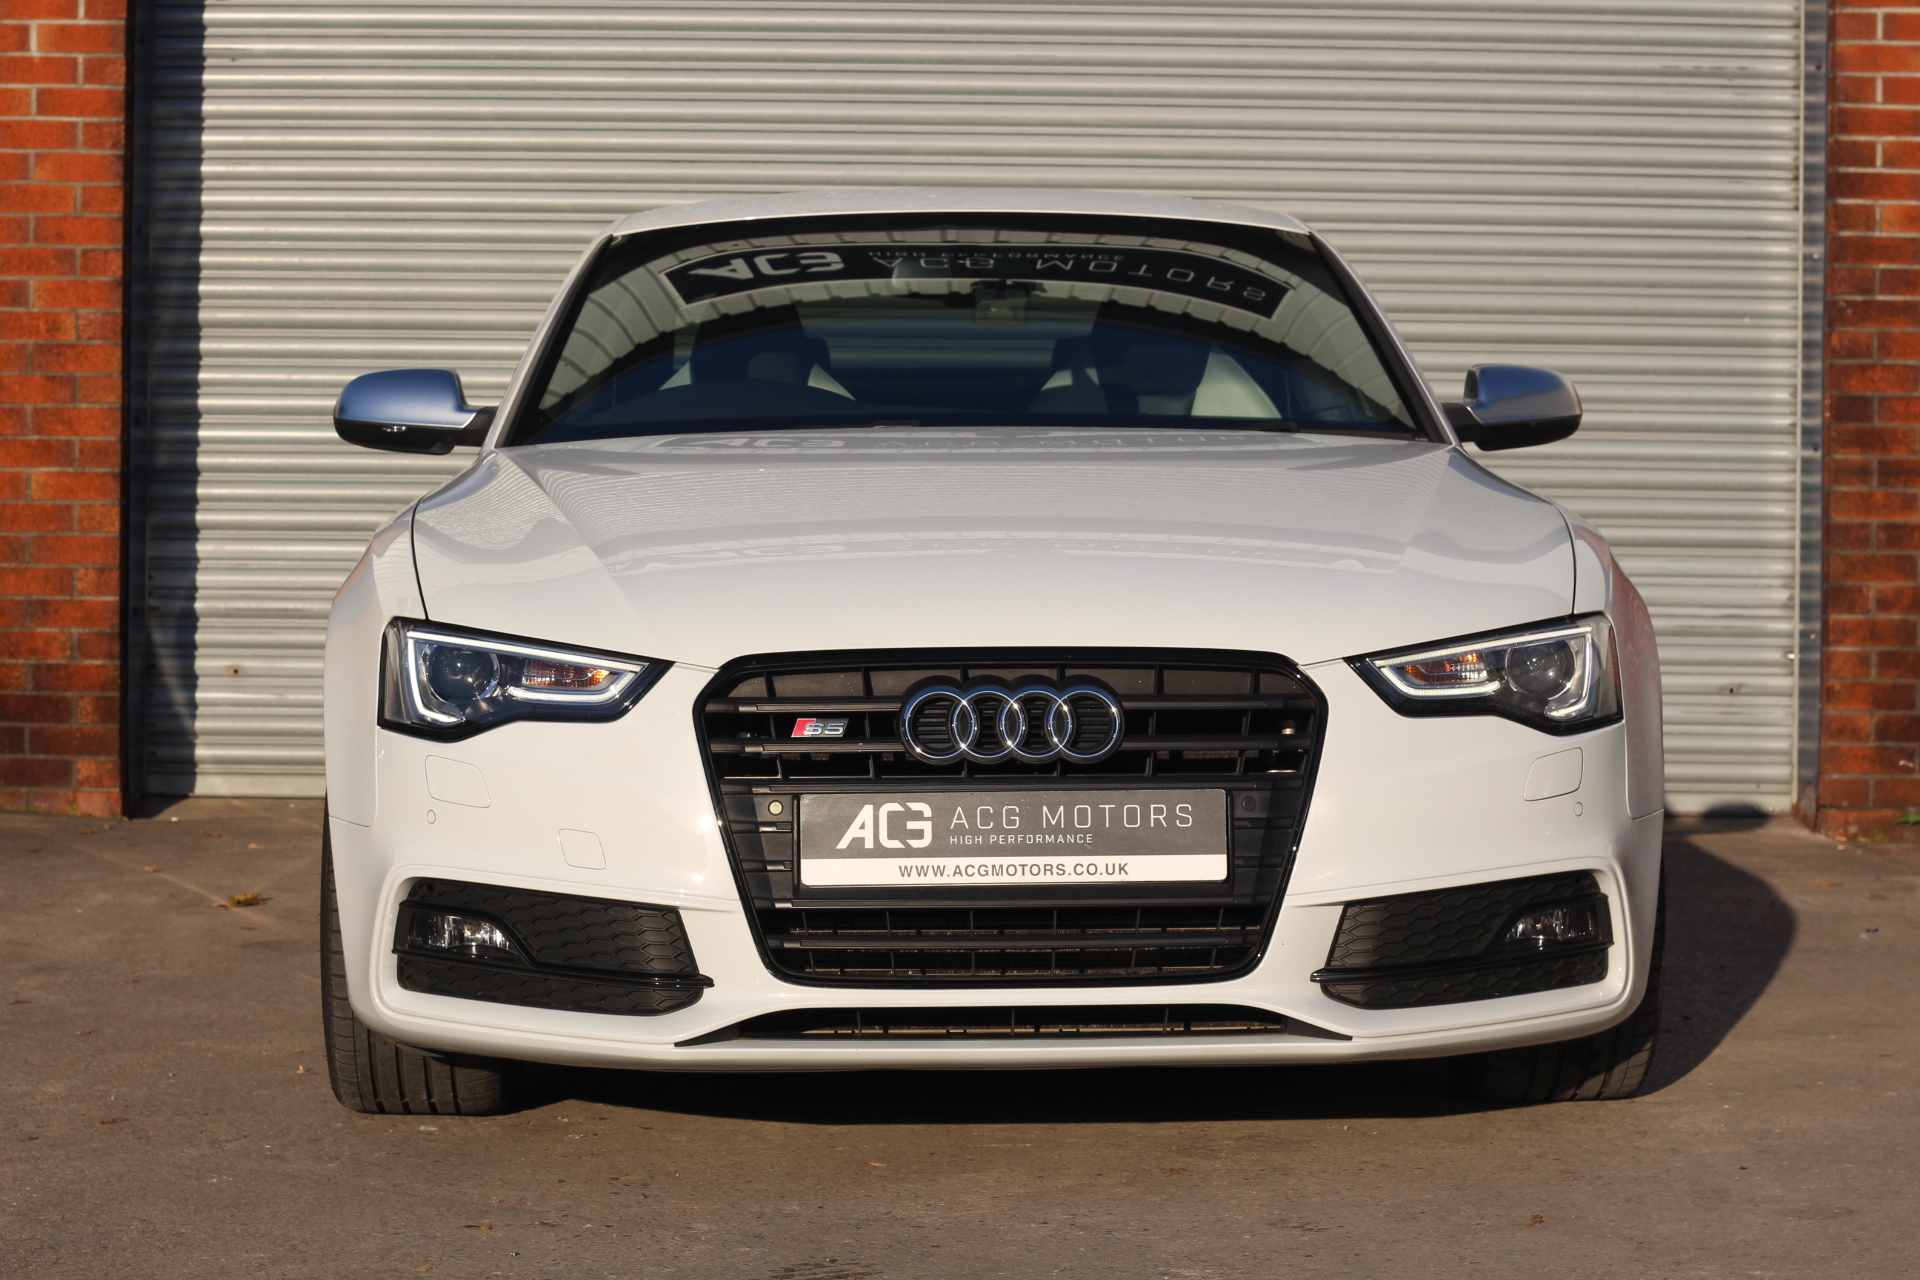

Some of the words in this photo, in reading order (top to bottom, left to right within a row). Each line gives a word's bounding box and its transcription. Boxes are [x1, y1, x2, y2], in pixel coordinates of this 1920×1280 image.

[803, 722, 845, 735] S5
[950, 805, 1020, 829] ACG
[1042, 803, 1193, 829] MOTORS
[835, 802, 932, 849] ACG
[949, 835, 983, 845] HIGH
[989, 834, 1093, 844] PERFORMANCE
[898, 863, 1129, 878] WWW.ACGMOTORS.CO.UK
